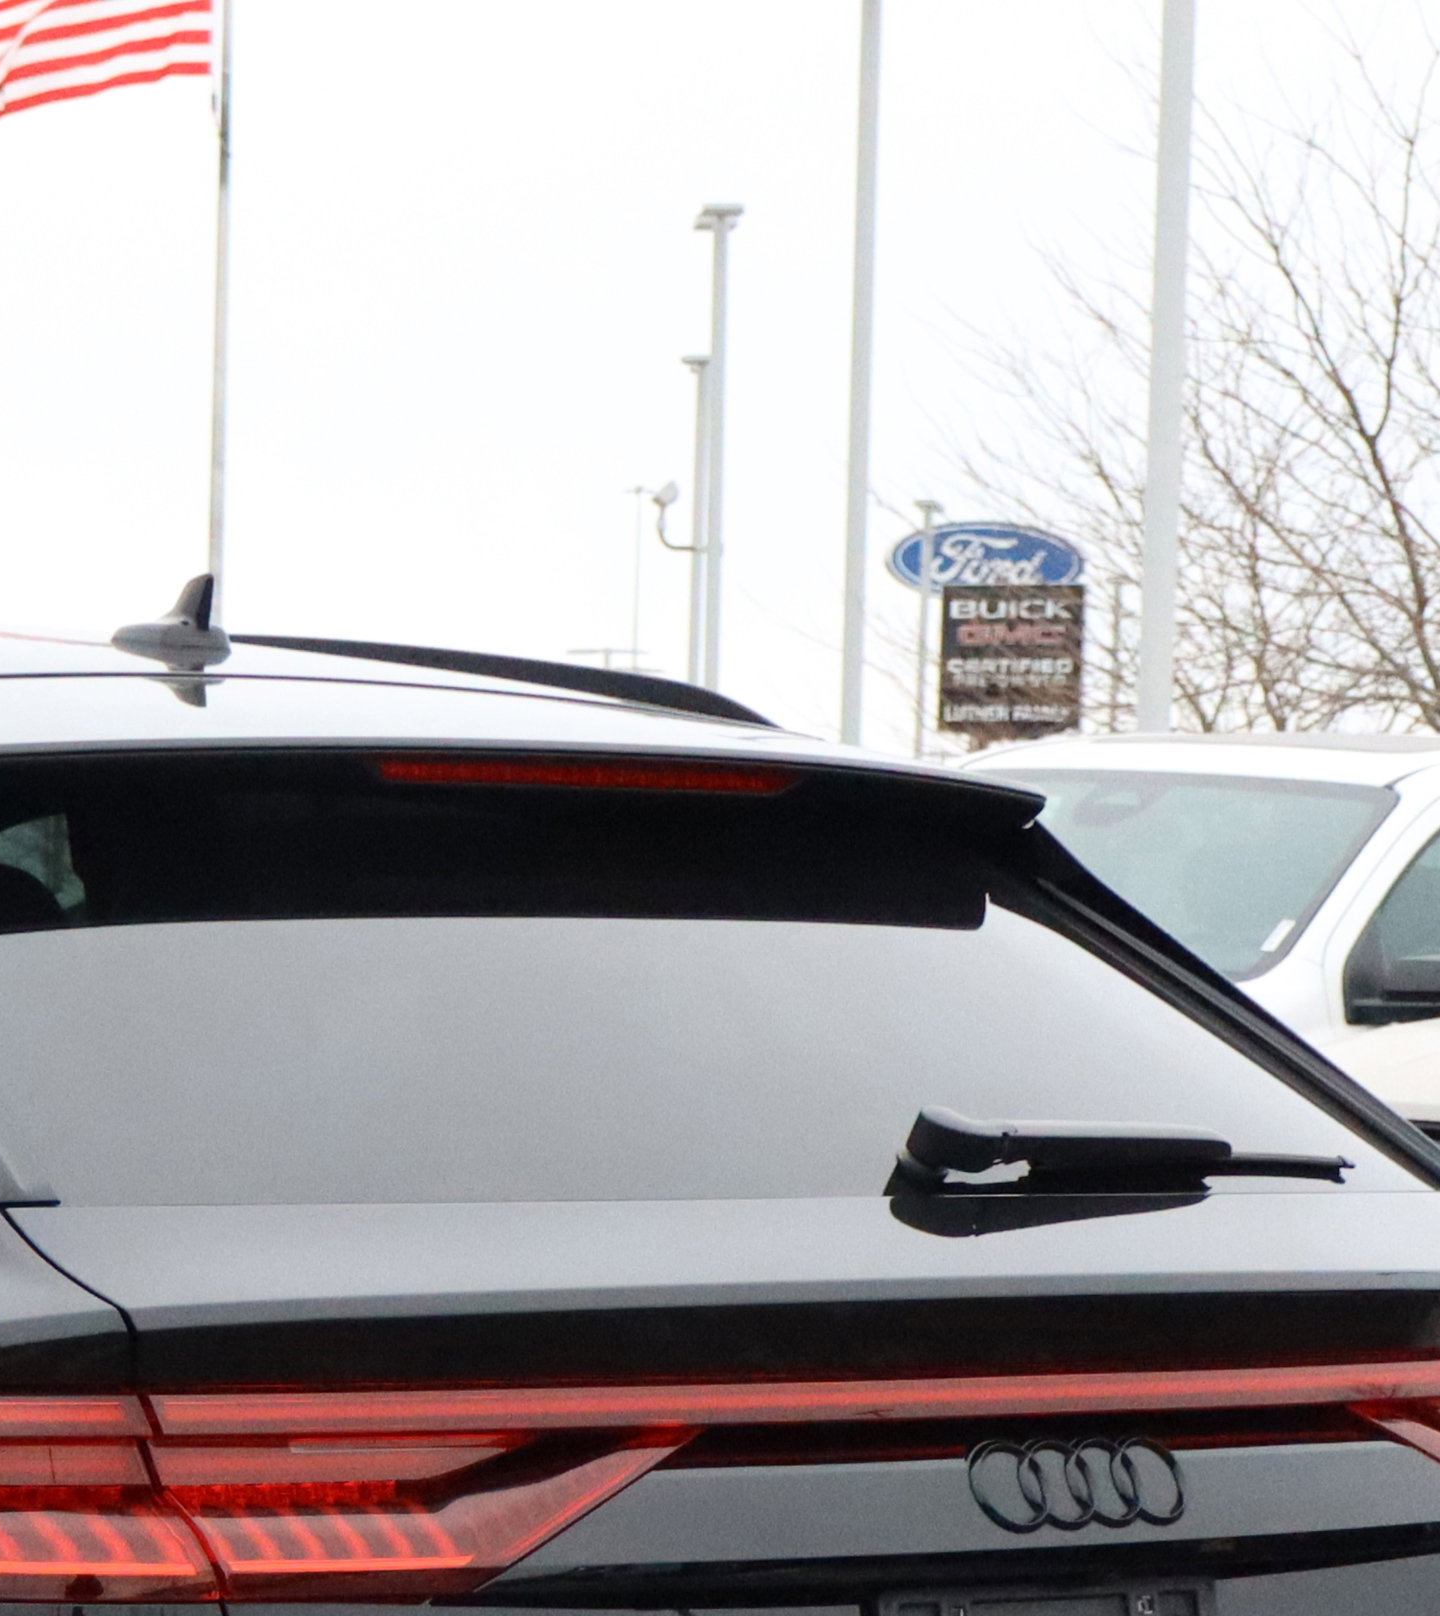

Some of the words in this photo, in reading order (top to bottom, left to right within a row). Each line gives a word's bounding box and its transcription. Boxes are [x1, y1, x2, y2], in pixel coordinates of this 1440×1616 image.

[928, 533, 1048, 585] Ford
[949, 598, 1071, 620] BUICK
[956, 623, 1069, 646] GMC
[946, 657, 1072, 675] CERTIFIED
